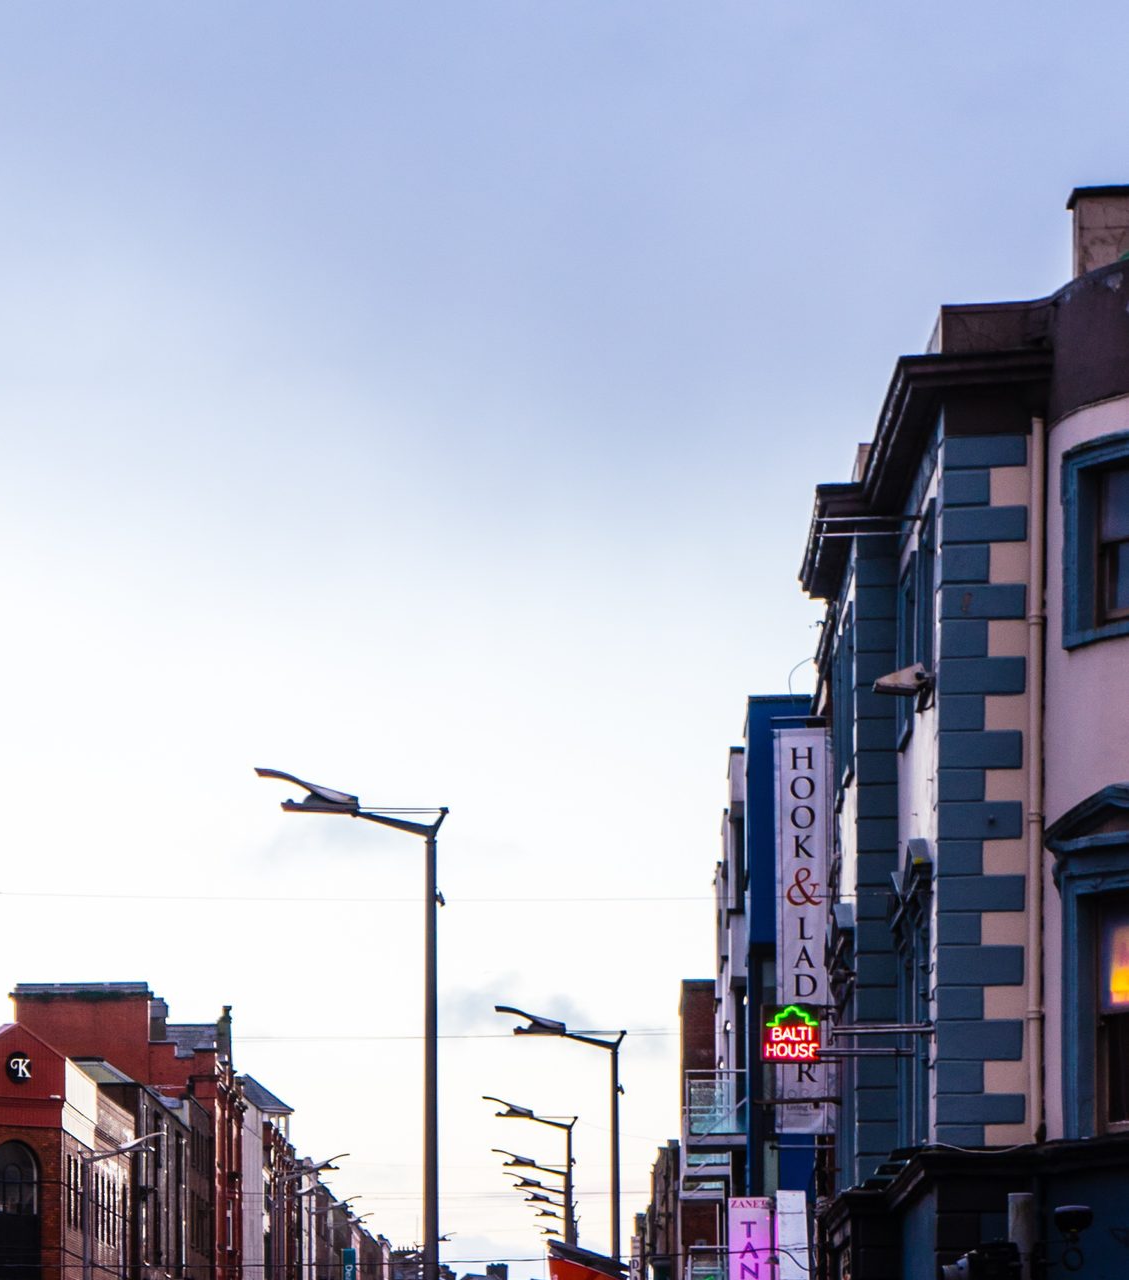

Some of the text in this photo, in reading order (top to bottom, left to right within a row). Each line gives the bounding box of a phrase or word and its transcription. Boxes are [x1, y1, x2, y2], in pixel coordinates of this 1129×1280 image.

[789, 746, 816, 859] HOOK
[786, 866, 823, 907] &
[792, 917, 819, 1082] LADR
[771, 1026, 813, 1041] BALTI
[765, 1043, 819, 1058] HOUSE
[10, 1058, 31, 1078] K
